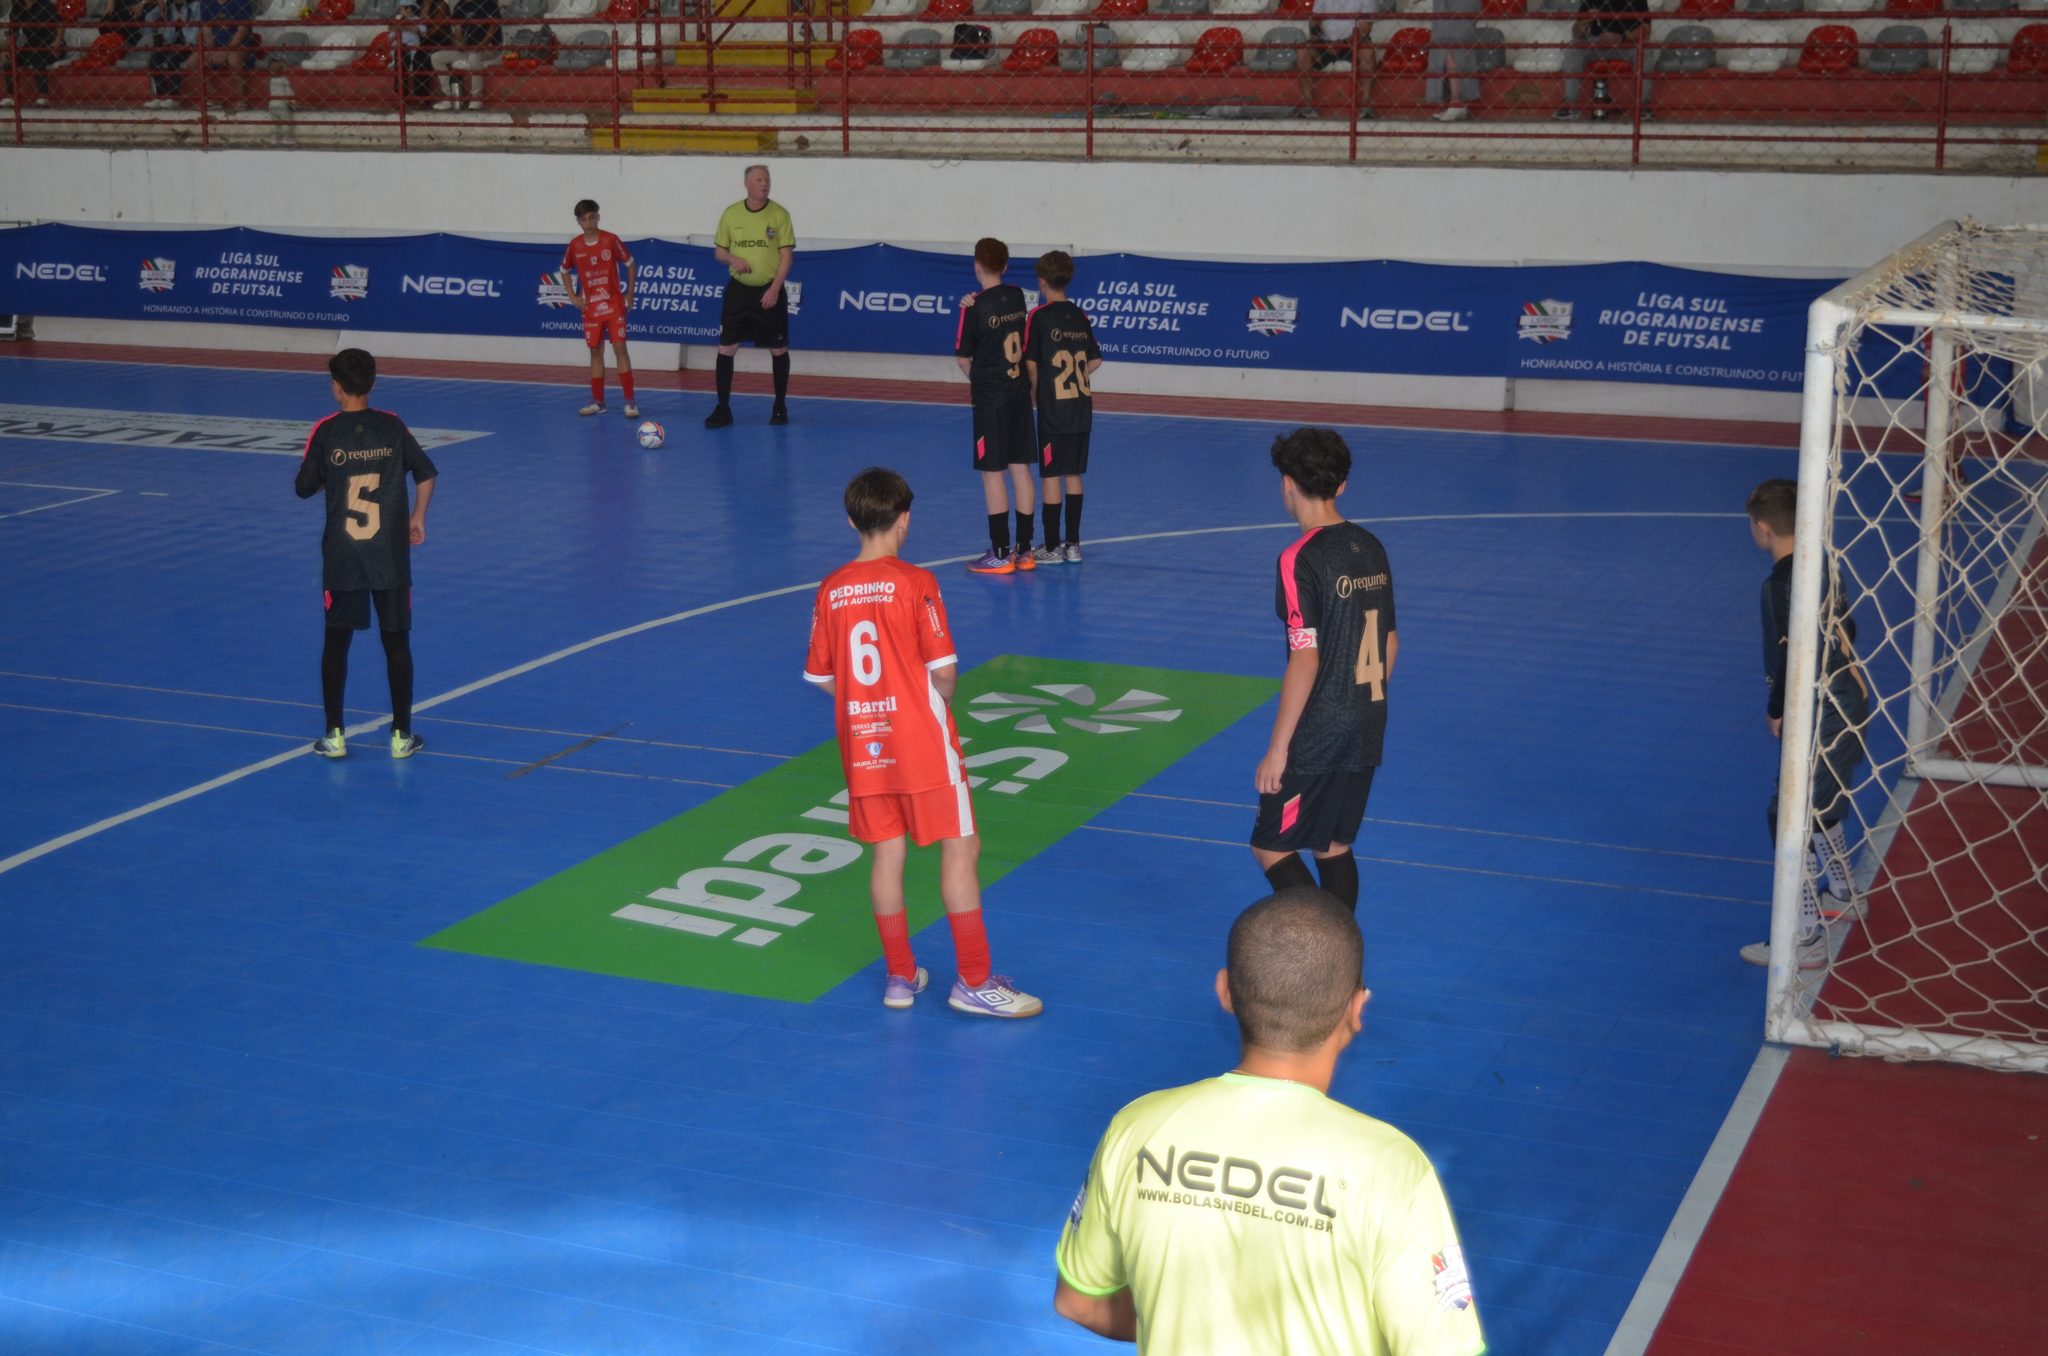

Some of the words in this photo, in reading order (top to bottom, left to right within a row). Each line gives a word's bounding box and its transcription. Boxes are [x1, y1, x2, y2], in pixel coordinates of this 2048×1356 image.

[735, 239, 769, 248] NEDEL
[220, 252, 251, 265] LIGA
[255, 254, 280, 267] SUL
[16, 262, 106, 282] NEDEL
[195, 267, 303, 283] RIOGRANDENSE
[637, 265, 664, 278] IGA
[667, 266, 696, 280] SUL
[212, 282, 229, 294] DE
[232, 283, 283, 297] FUTSAL
[402, 274, 501, 297] NEDEL
[1097, 281, 1139, 296] LIGA
[1143, 283, 1177, 298] SUL
[641, 298, 699, 312] FUTSAL
[839, 289, 951, 315] NEDEL
[1636, 292, 1685, 311] LIGA
[1689, 297, 1728, 314] SUL
[144, 305, 192, 314] HONRANDO
[202, 305, 238, 316] HISTÓRIA
[246, 308, 306, 320] CONSTRUINDO
[307, 312, 315, 320] O
[316, 312, 350, 322] FUTURO
[1087, 315, 1109, 328] DE
[1112, 315, 1182, 331] FUTSAL
[1340, 306, 1470, 332] NEDEL
[1598, 310, 1764, 333] RIOGRANDENSE
[656, 325, 723, 337] CONSTRUIND
[1623, 330, 1650, 345] DE
[1654, 331, 1732, 350] FUTSAL
[1003, 331, 1023, 379] 9
[1131, 344, 1211, 358] CONSTRUINDO
[1213, 348, 1223, 358] O
[1225, 349, 1270, 360] FUTURO
[1051, 350, 1091, 400] 20
[1520, 358, 1593, 370] HONRANDO
[1595, 360, 1605, 370] A
[1607, 359, 1663, 374] HISTÓRIA
[1665, 364, 1672, 375] E
[1675, 364, 1765, 380] CONSTRUINDO
[1768, 369, 1778, 381] O
[348, 447, 393, 461] requinte
[345, 473, 381, 540] 5
[829, 581, 896, 601] PEDRINHO
[1352, 573, 1388, 592] requinte
[850, 620, 882, 686] 6
[1355, 609, 1385, 702] 4
[848, 696, 897, 715] Barril
[851, 723, 870, 731] TERRAS
[1136, 1145, 1337, 1219] NEDEL
[1136, 1187, 1334, 1234] WWW.BOLASNEDEL.COM.BR
